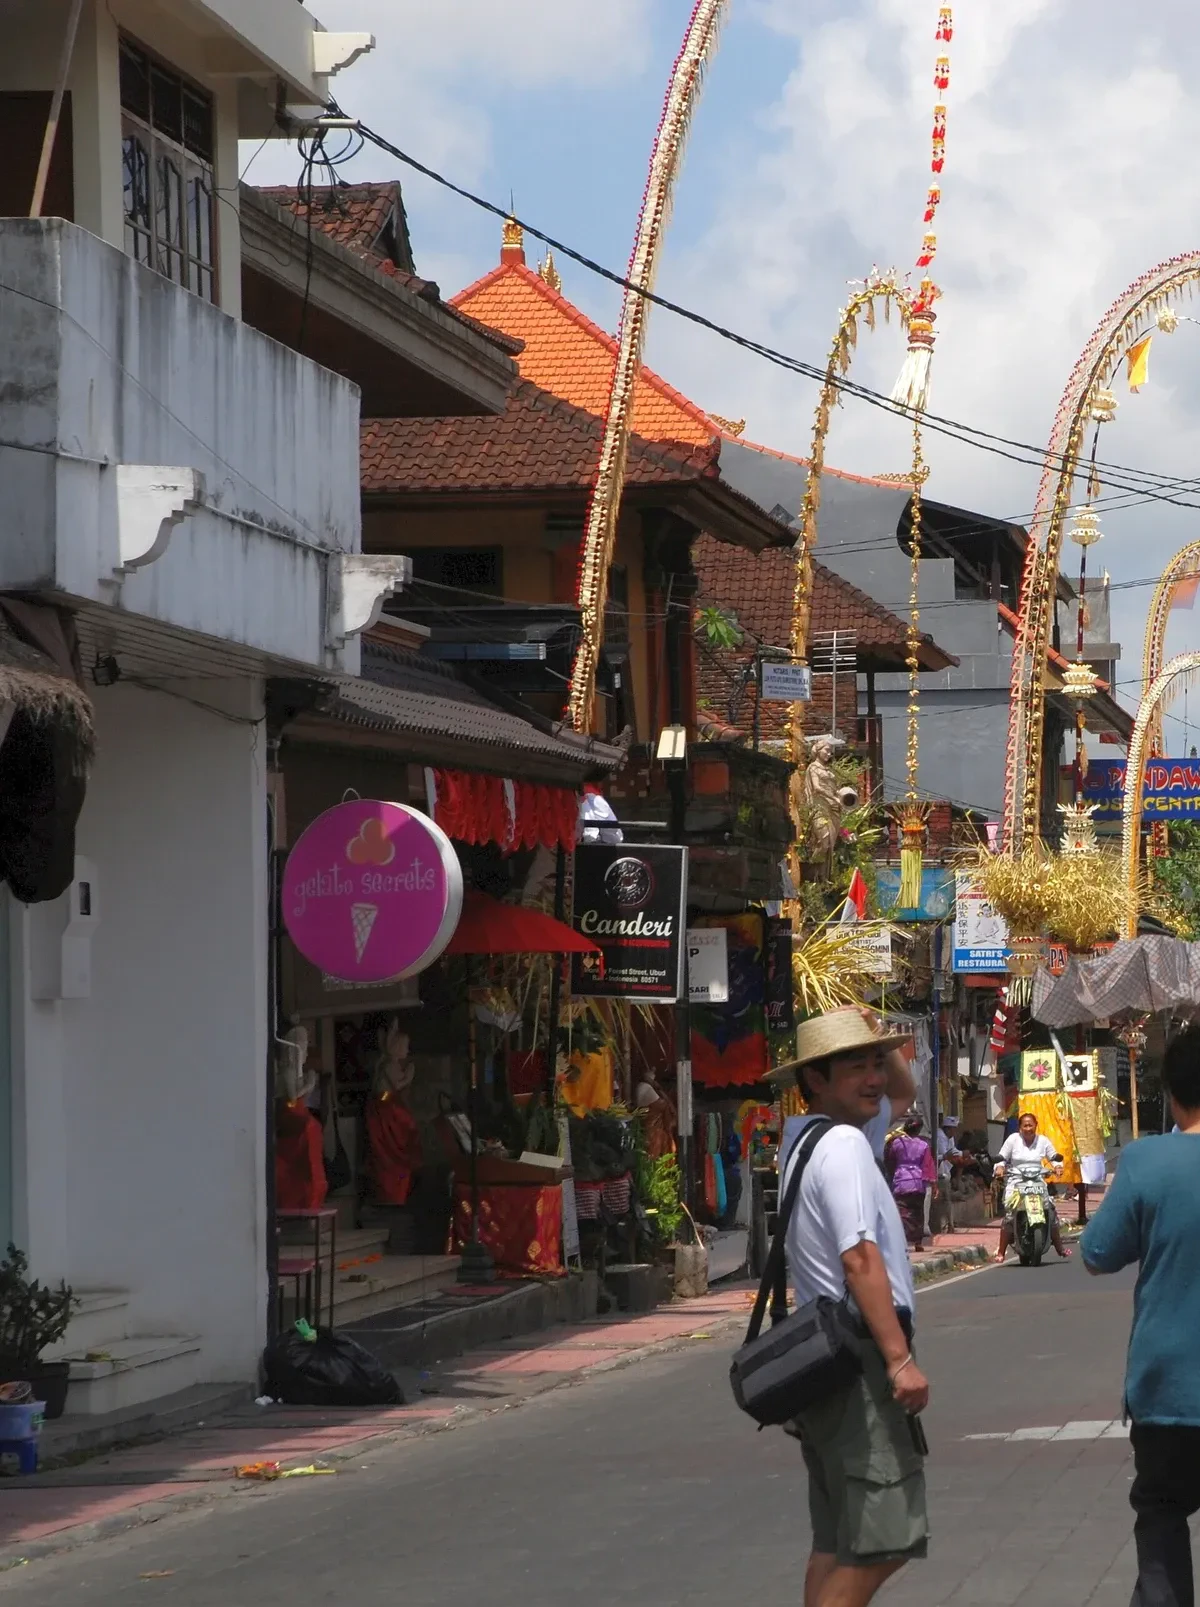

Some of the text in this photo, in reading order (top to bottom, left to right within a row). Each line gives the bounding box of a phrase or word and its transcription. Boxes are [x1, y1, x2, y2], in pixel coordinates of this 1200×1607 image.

[292, 857, 436, 917] gelato secrets
[581, 909, 672, 937] Canderi
[969, 950, 1003, 958] SATRI'S
[649, 969, 667, 977] Ubud
